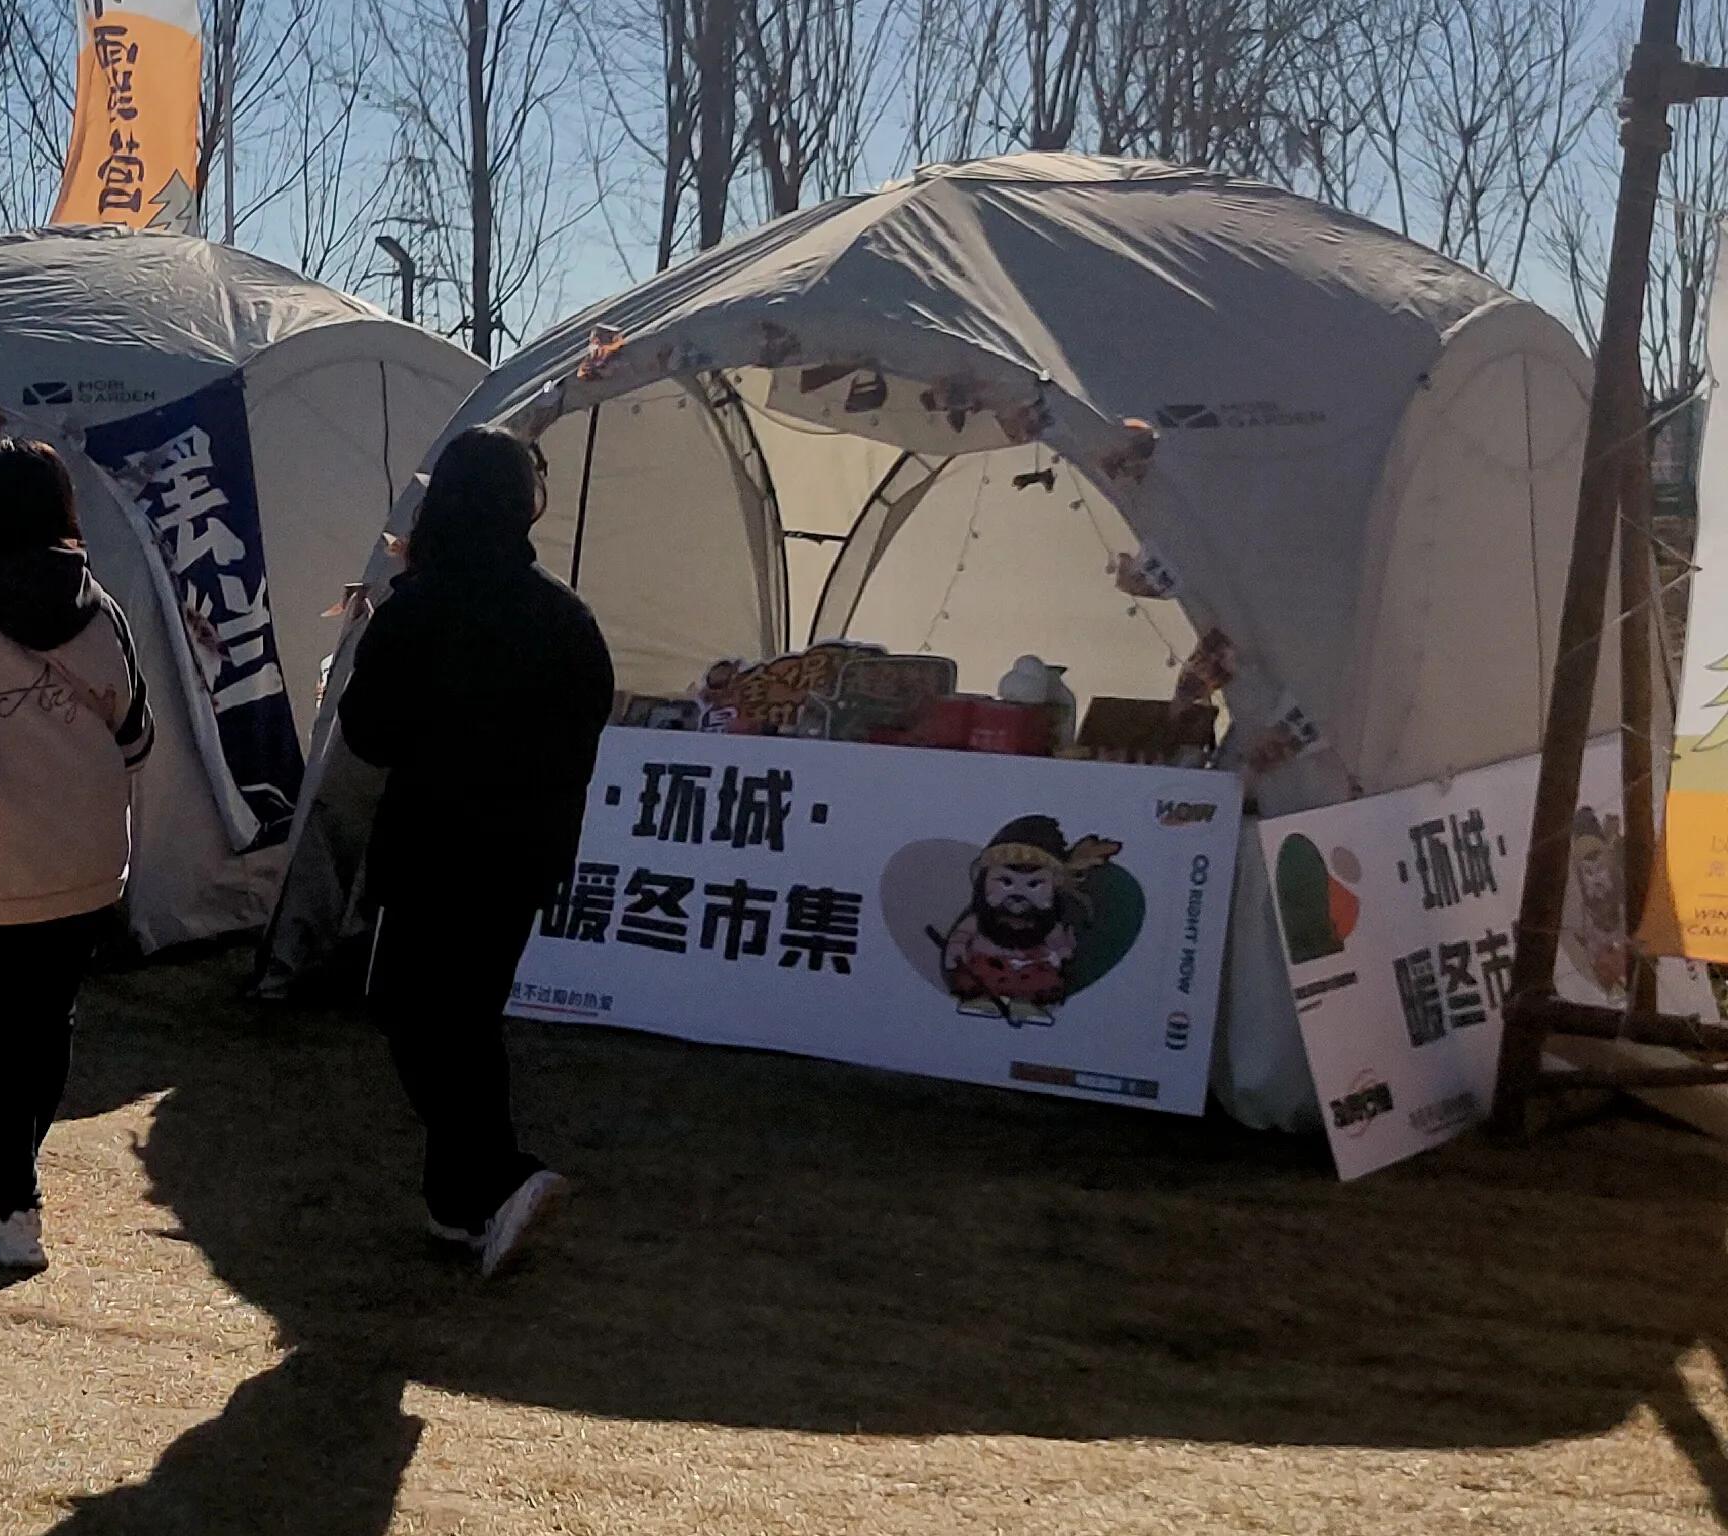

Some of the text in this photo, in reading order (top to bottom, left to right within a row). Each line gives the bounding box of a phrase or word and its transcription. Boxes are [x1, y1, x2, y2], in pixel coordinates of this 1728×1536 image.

[540, 861, 864, 976] 暖冬市集
[1392, 918, 1521, 1049] 暖冬市
